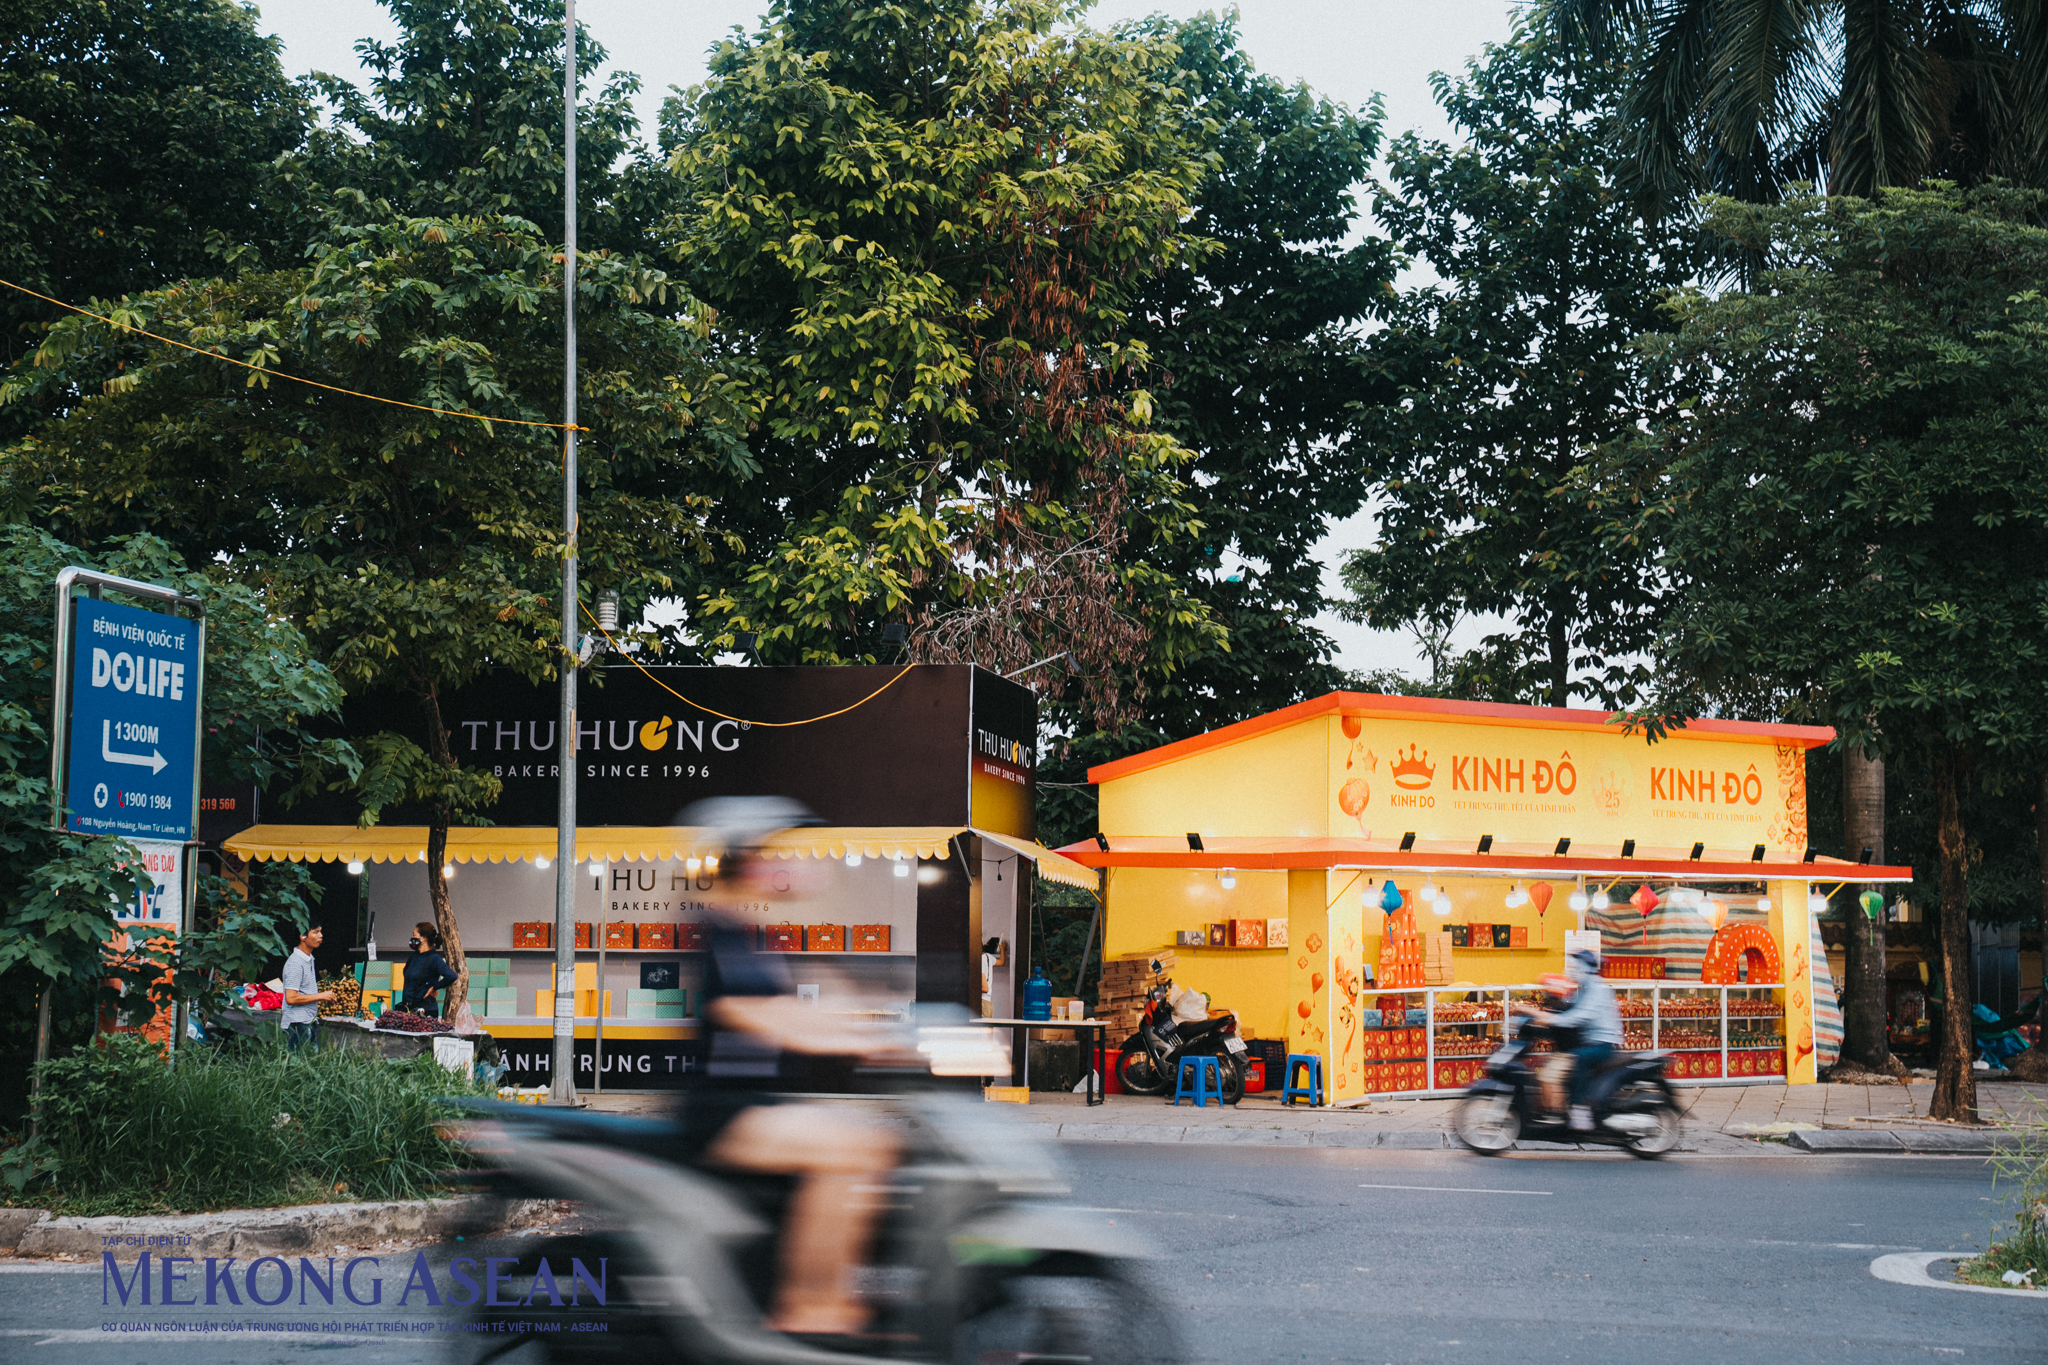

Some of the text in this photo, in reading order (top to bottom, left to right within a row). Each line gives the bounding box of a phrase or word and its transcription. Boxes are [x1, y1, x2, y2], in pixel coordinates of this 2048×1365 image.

[93, 616, 186, 650] BỆNH VIỆN QUỐC TẾ
[92, 647, 184, 701] DOLIFE
[114, 721, 159, 744] 1300M
[462, 720, 555, 751] THU
[978, 728, 998, 757] THU
[494, 766, 710, 778] BAKER SINCE 1996
[984, 763, 1026, 785] BAKERY SINCE 1996
[1452, 750, 1577, 796] KINH ĐÔ
[1651, 763, 1762, 806] KINH ĐÔ
[124, 792, 172, 810] 1900 1984
[201, 798, 236, 810] 319 560
[1390, 794, 1435, 808] KINH DO
[1468, 801, 1492, 811] TRUNG
[1605, 792, 1620, 808] 25
[82, 817, 92, 826] 108
[1666, 810, 1687, 819] TRUNG
[612, 901, 670, 911] BAKERY
[680, 901, 716, 911] SINC
[573, 1054, 651, 1073] RUNG
